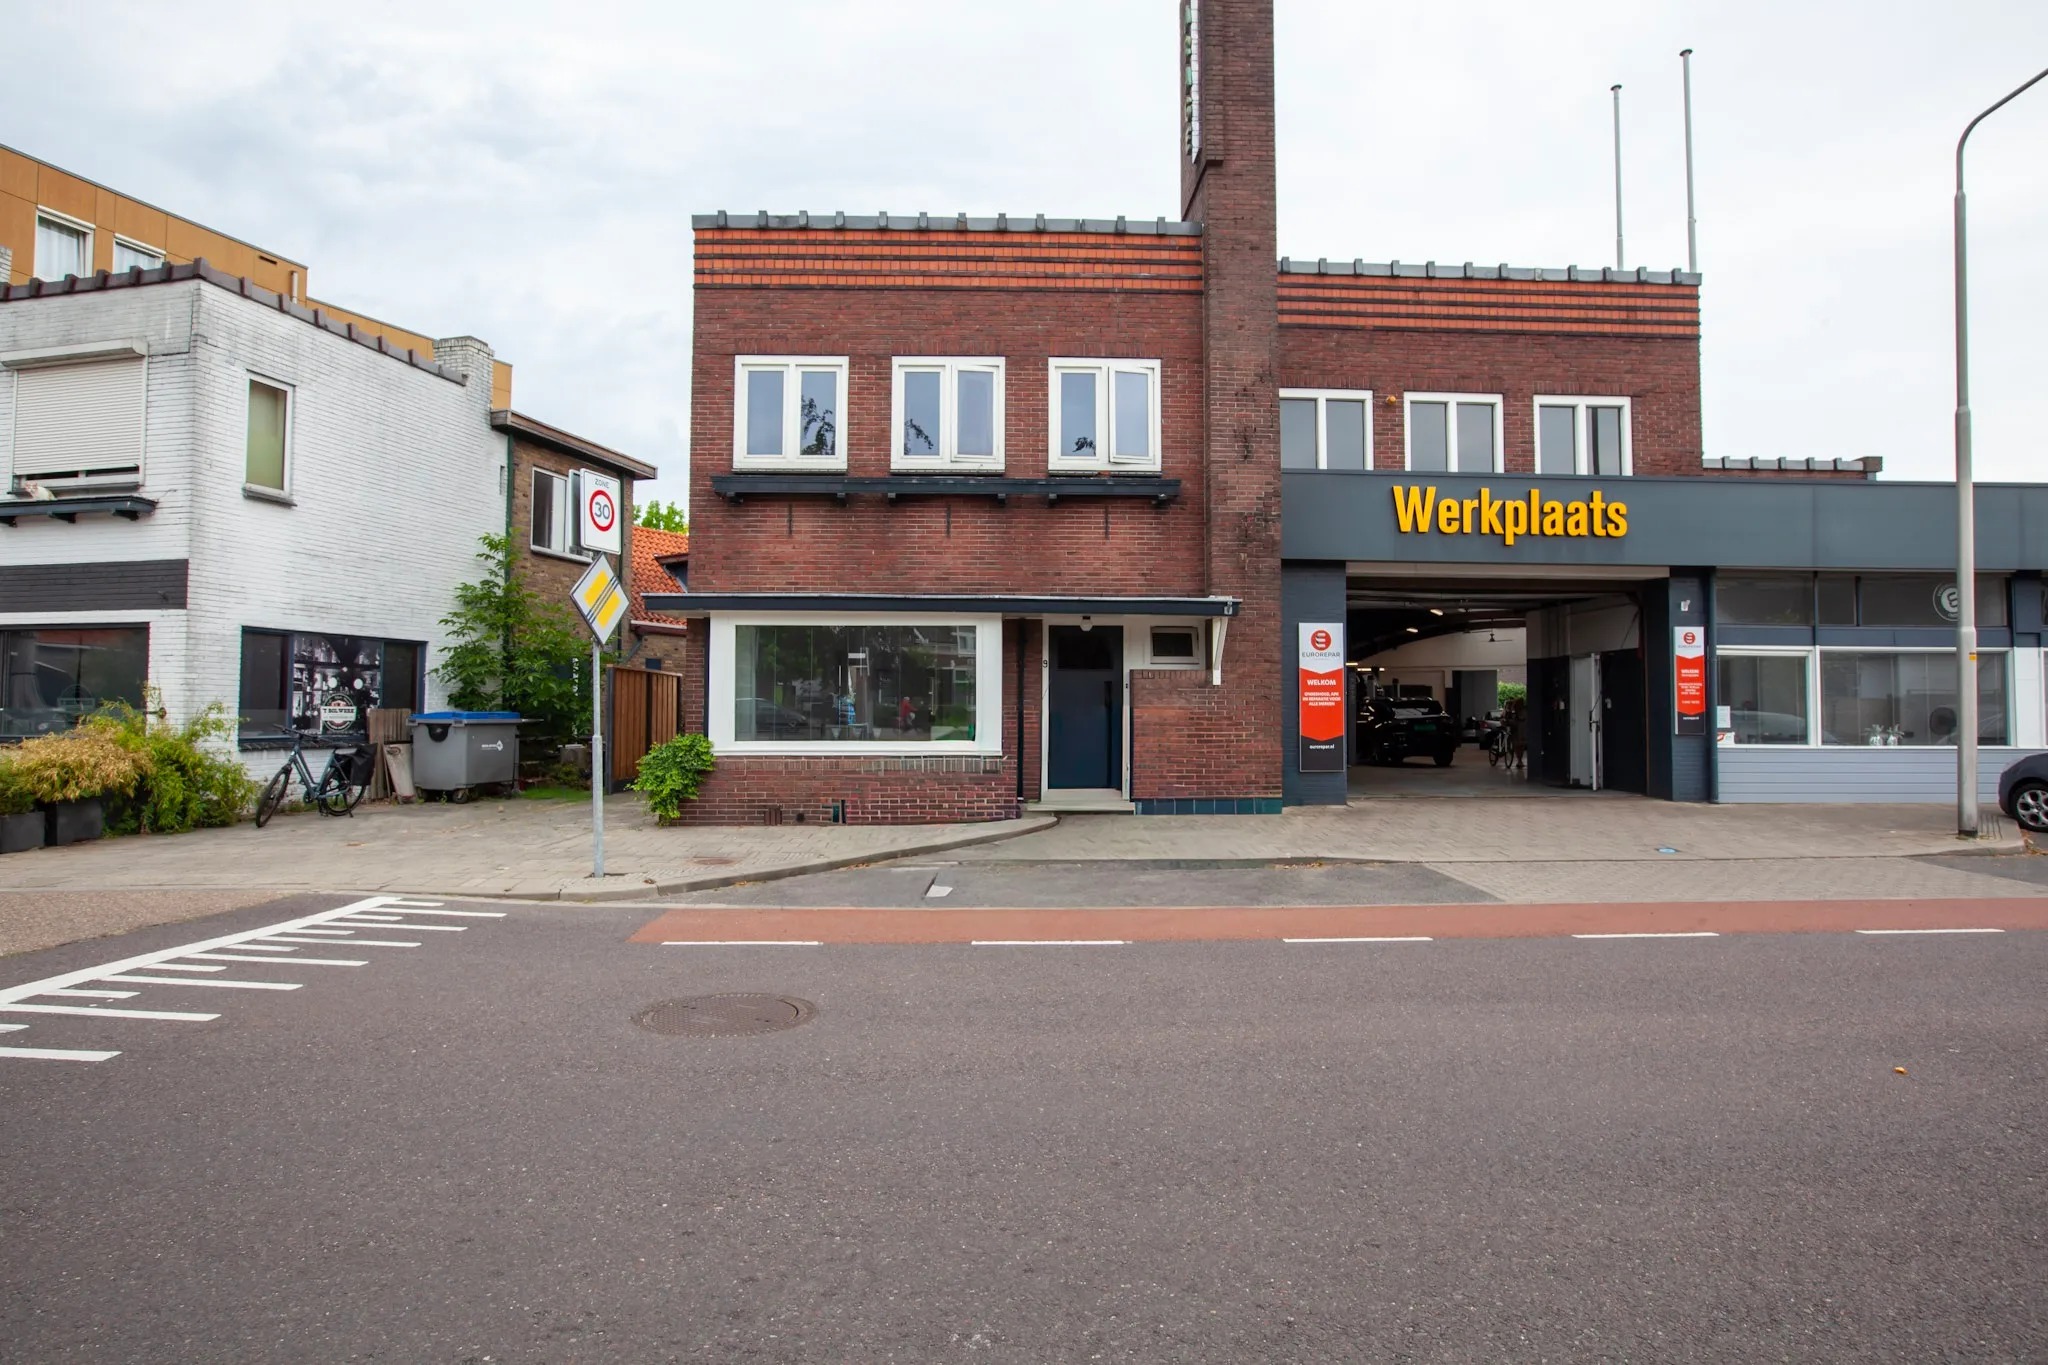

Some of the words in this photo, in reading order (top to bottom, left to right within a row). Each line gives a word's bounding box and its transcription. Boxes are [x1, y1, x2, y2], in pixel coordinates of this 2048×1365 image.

[594, 478, 610, 489] ZONE
[594, 501, 611, 520] 30
[1393, 485, 1628, 546] Werkplaats
